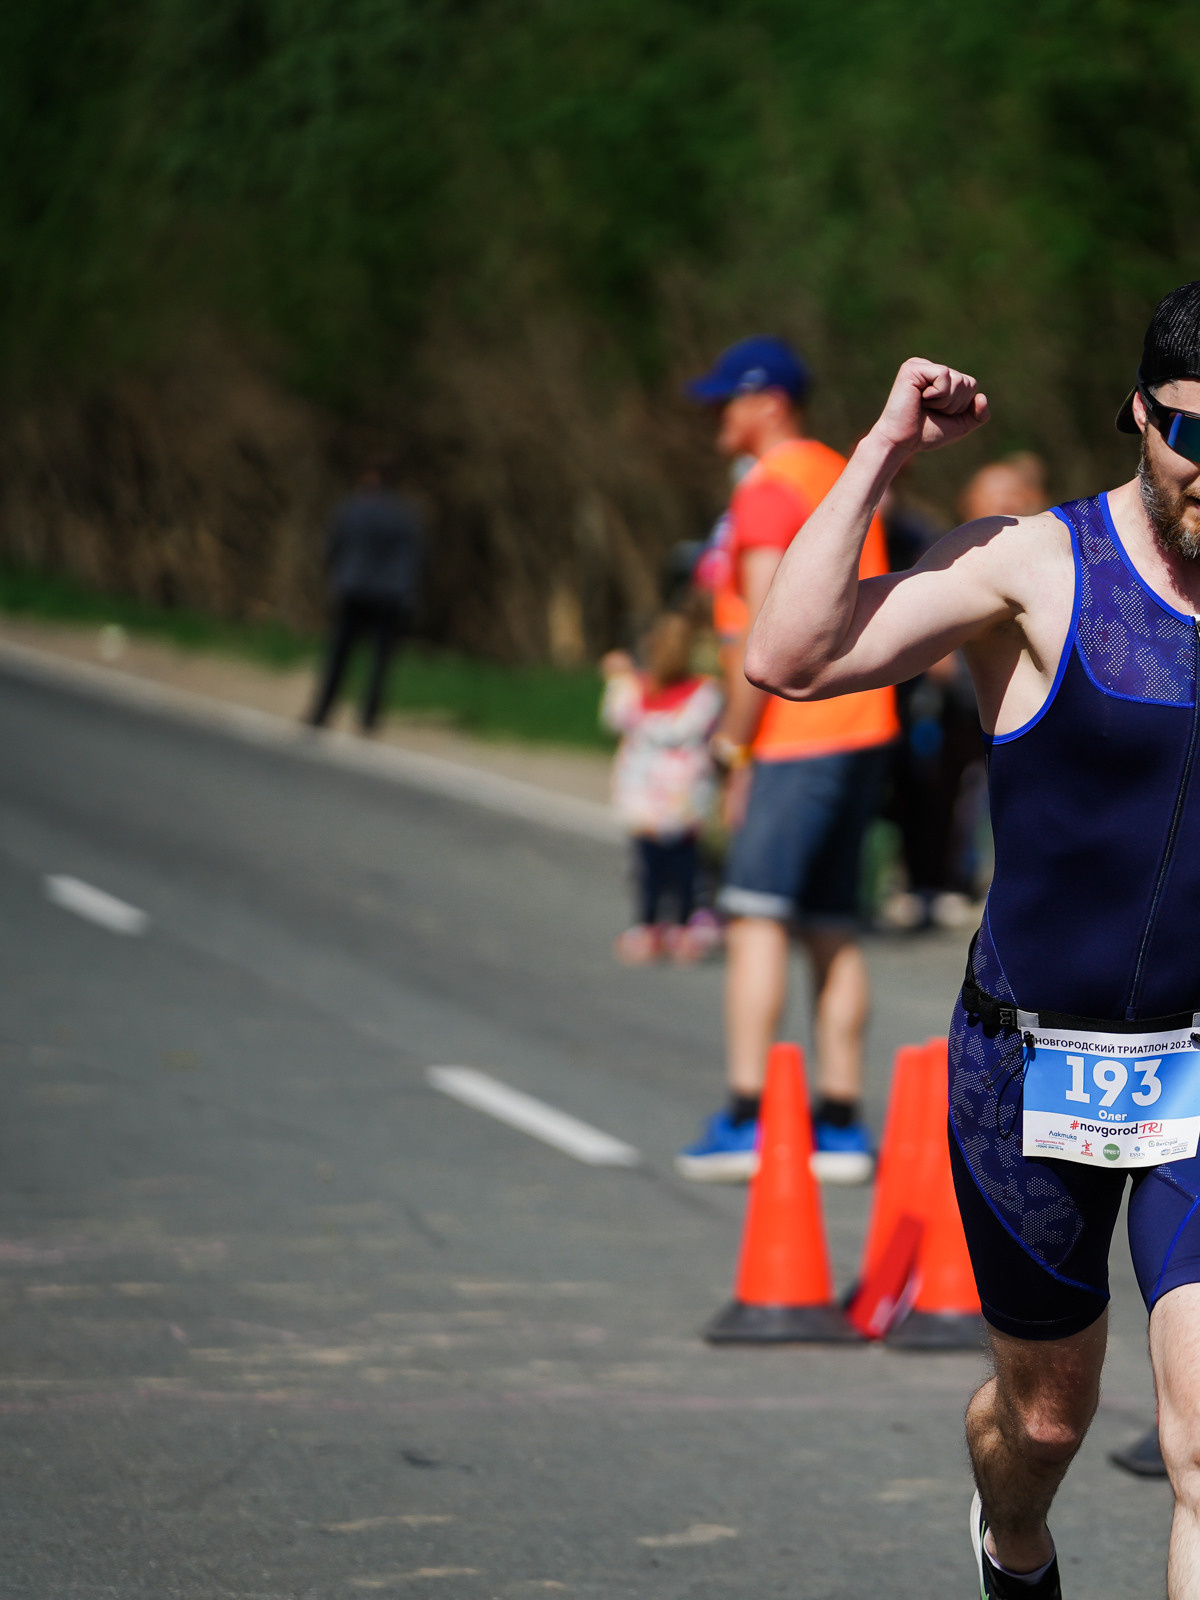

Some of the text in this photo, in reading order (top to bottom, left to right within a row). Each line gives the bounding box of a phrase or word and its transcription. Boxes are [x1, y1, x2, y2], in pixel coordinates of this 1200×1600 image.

[1035, 1037, 1192, 1054] НОВГОРОДСКИЙ ТРИАТЛОН 2023
[1065, 1055, 1162, 1107] 193
[1098, 1110, 1127, 1121] Олег
